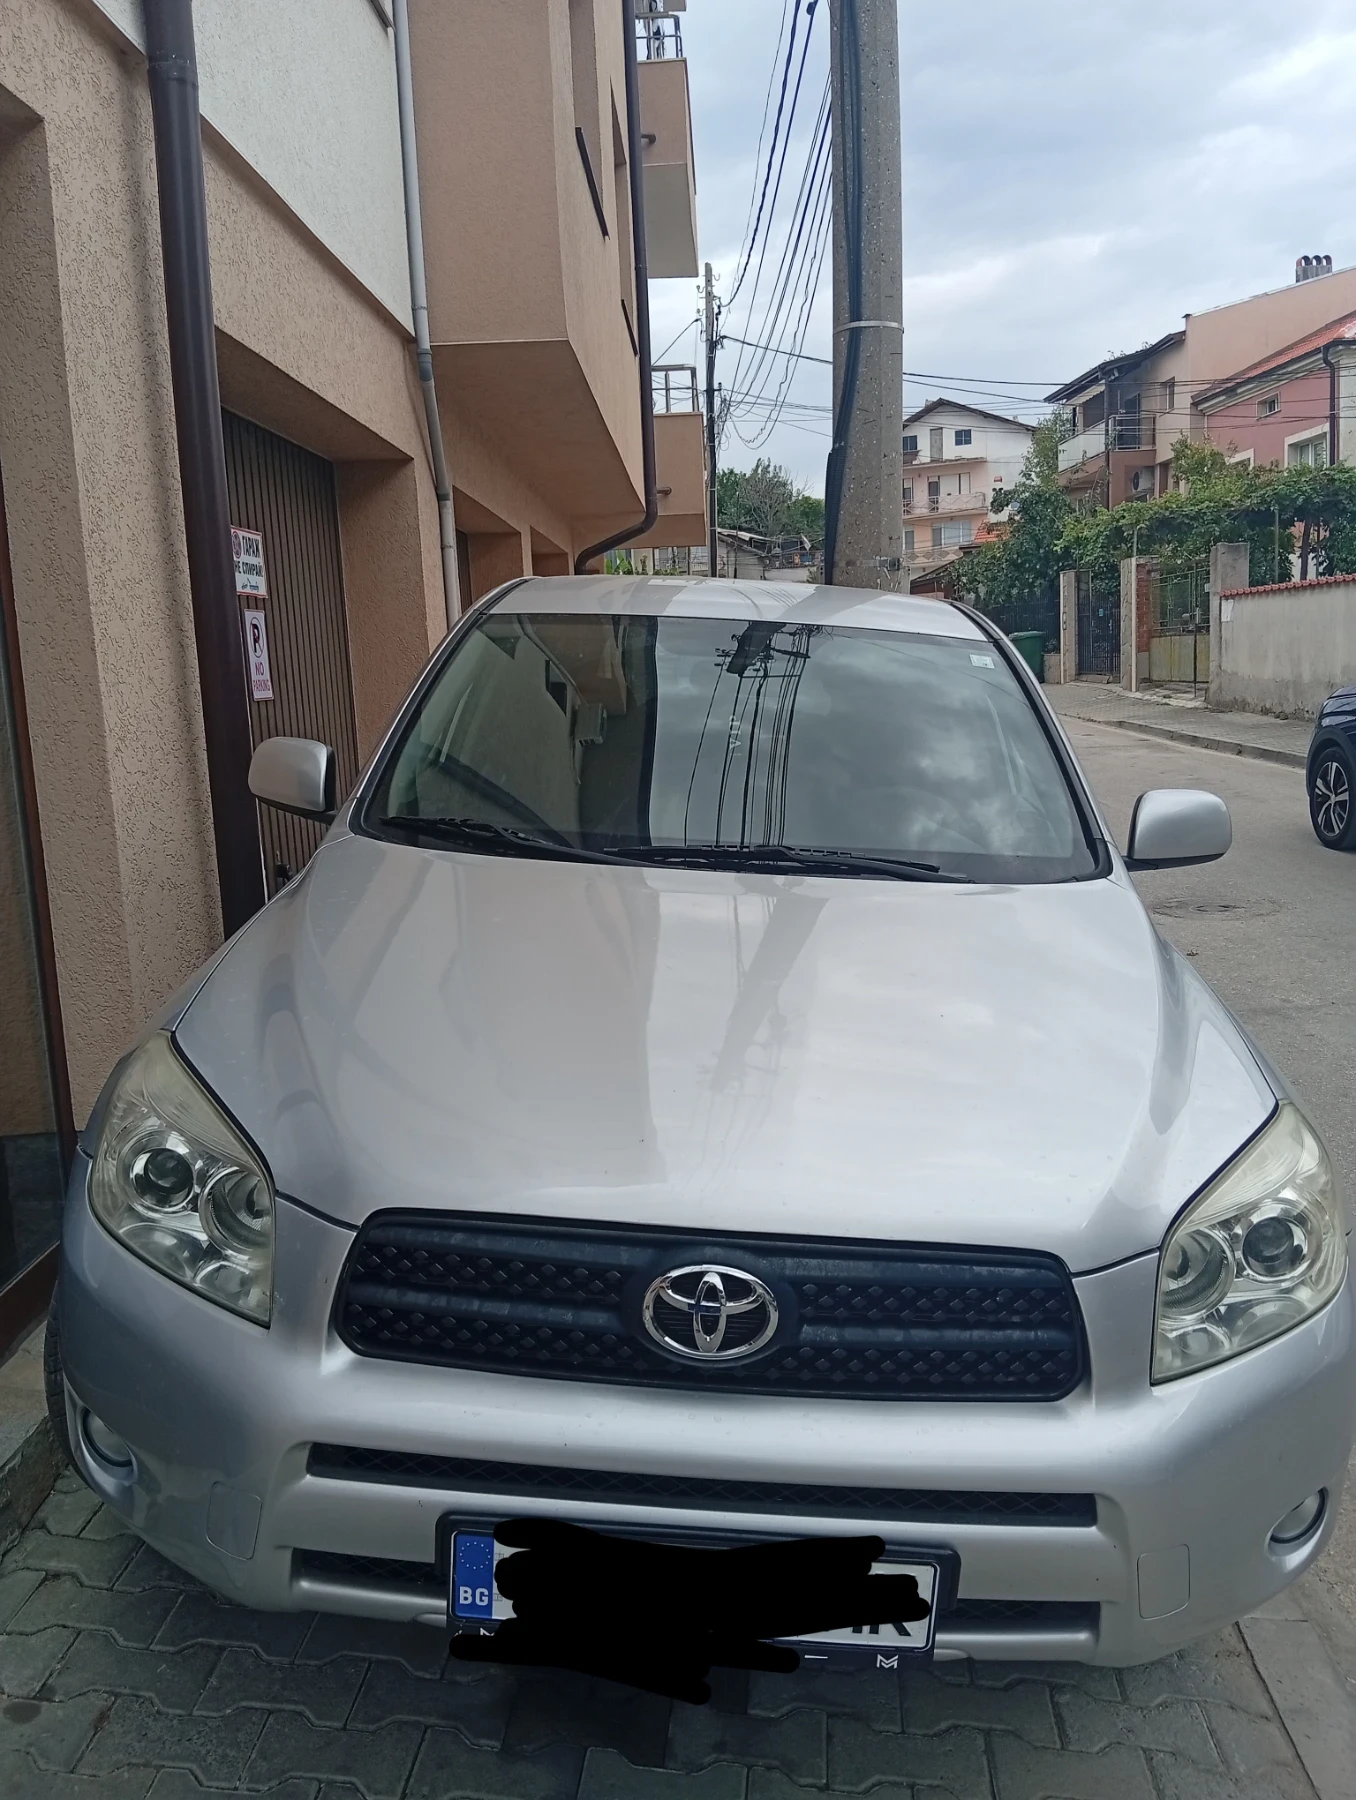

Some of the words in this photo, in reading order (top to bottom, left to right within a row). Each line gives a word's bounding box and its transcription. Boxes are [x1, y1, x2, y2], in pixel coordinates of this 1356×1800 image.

[242, 535, 260, 558] ГАРАЖ
[234, 560, 241, 574] НЕ
[254, 661, 264, 676] NO
[253, 679, 270, 691] PARKING
[459, 1586, 489, 1606] BG
